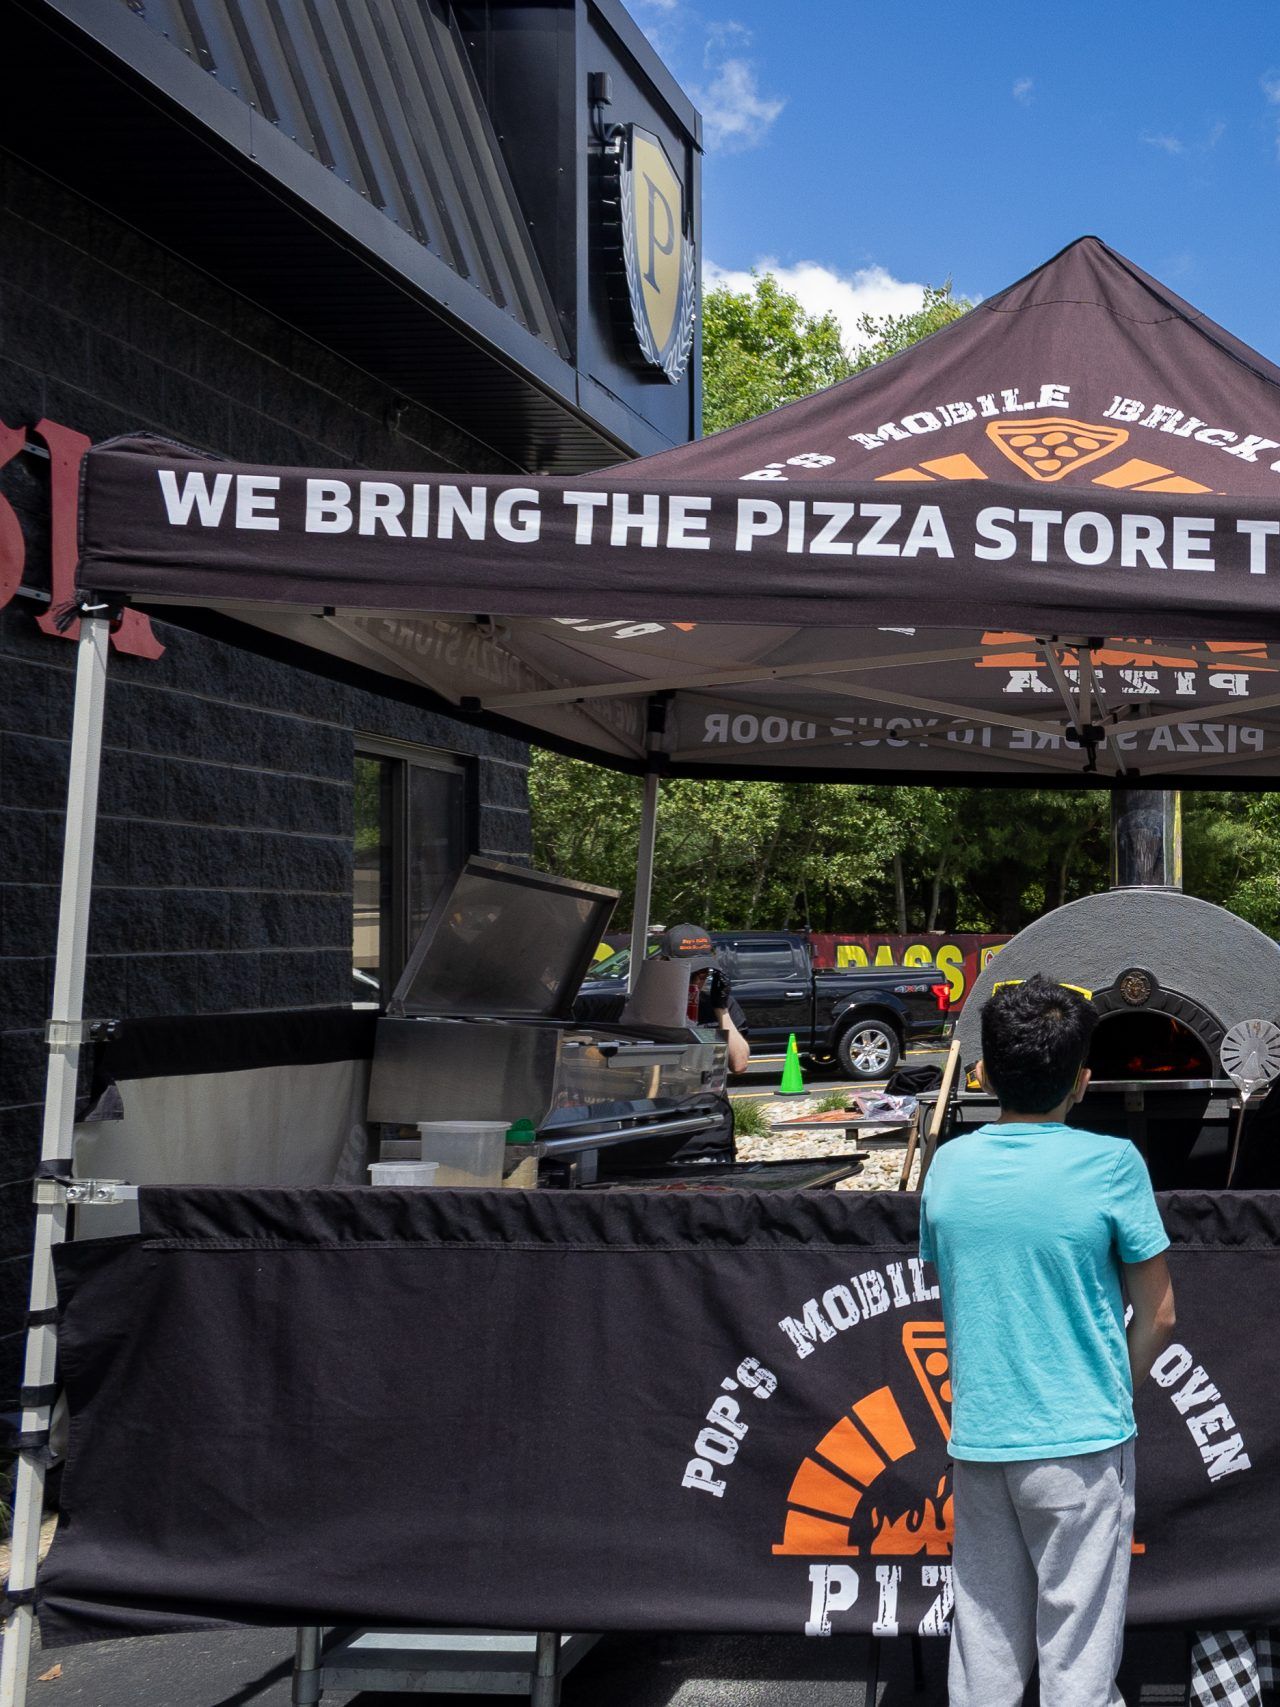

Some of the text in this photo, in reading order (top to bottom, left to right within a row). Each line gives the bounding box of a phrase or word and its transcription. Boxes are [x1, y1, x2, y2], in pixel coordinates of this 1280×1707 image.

[642, 171, 675, 294] P
[848, 384, 1070, 450] MOBILE
[1103, 396, 1280, 463] BRICK
[158, 470, 280, 530] WE
[306, 479, 541, 543] BRING
[564, 490, 711, 550] THE
[736, 498, 955, 559] PIZZA
[974, 507, 1215, 572] STORE
[681, 1258, 1252, 1498] POP'S MOBIL OVEN
[804, 1564, 953, 1637] PIZ
